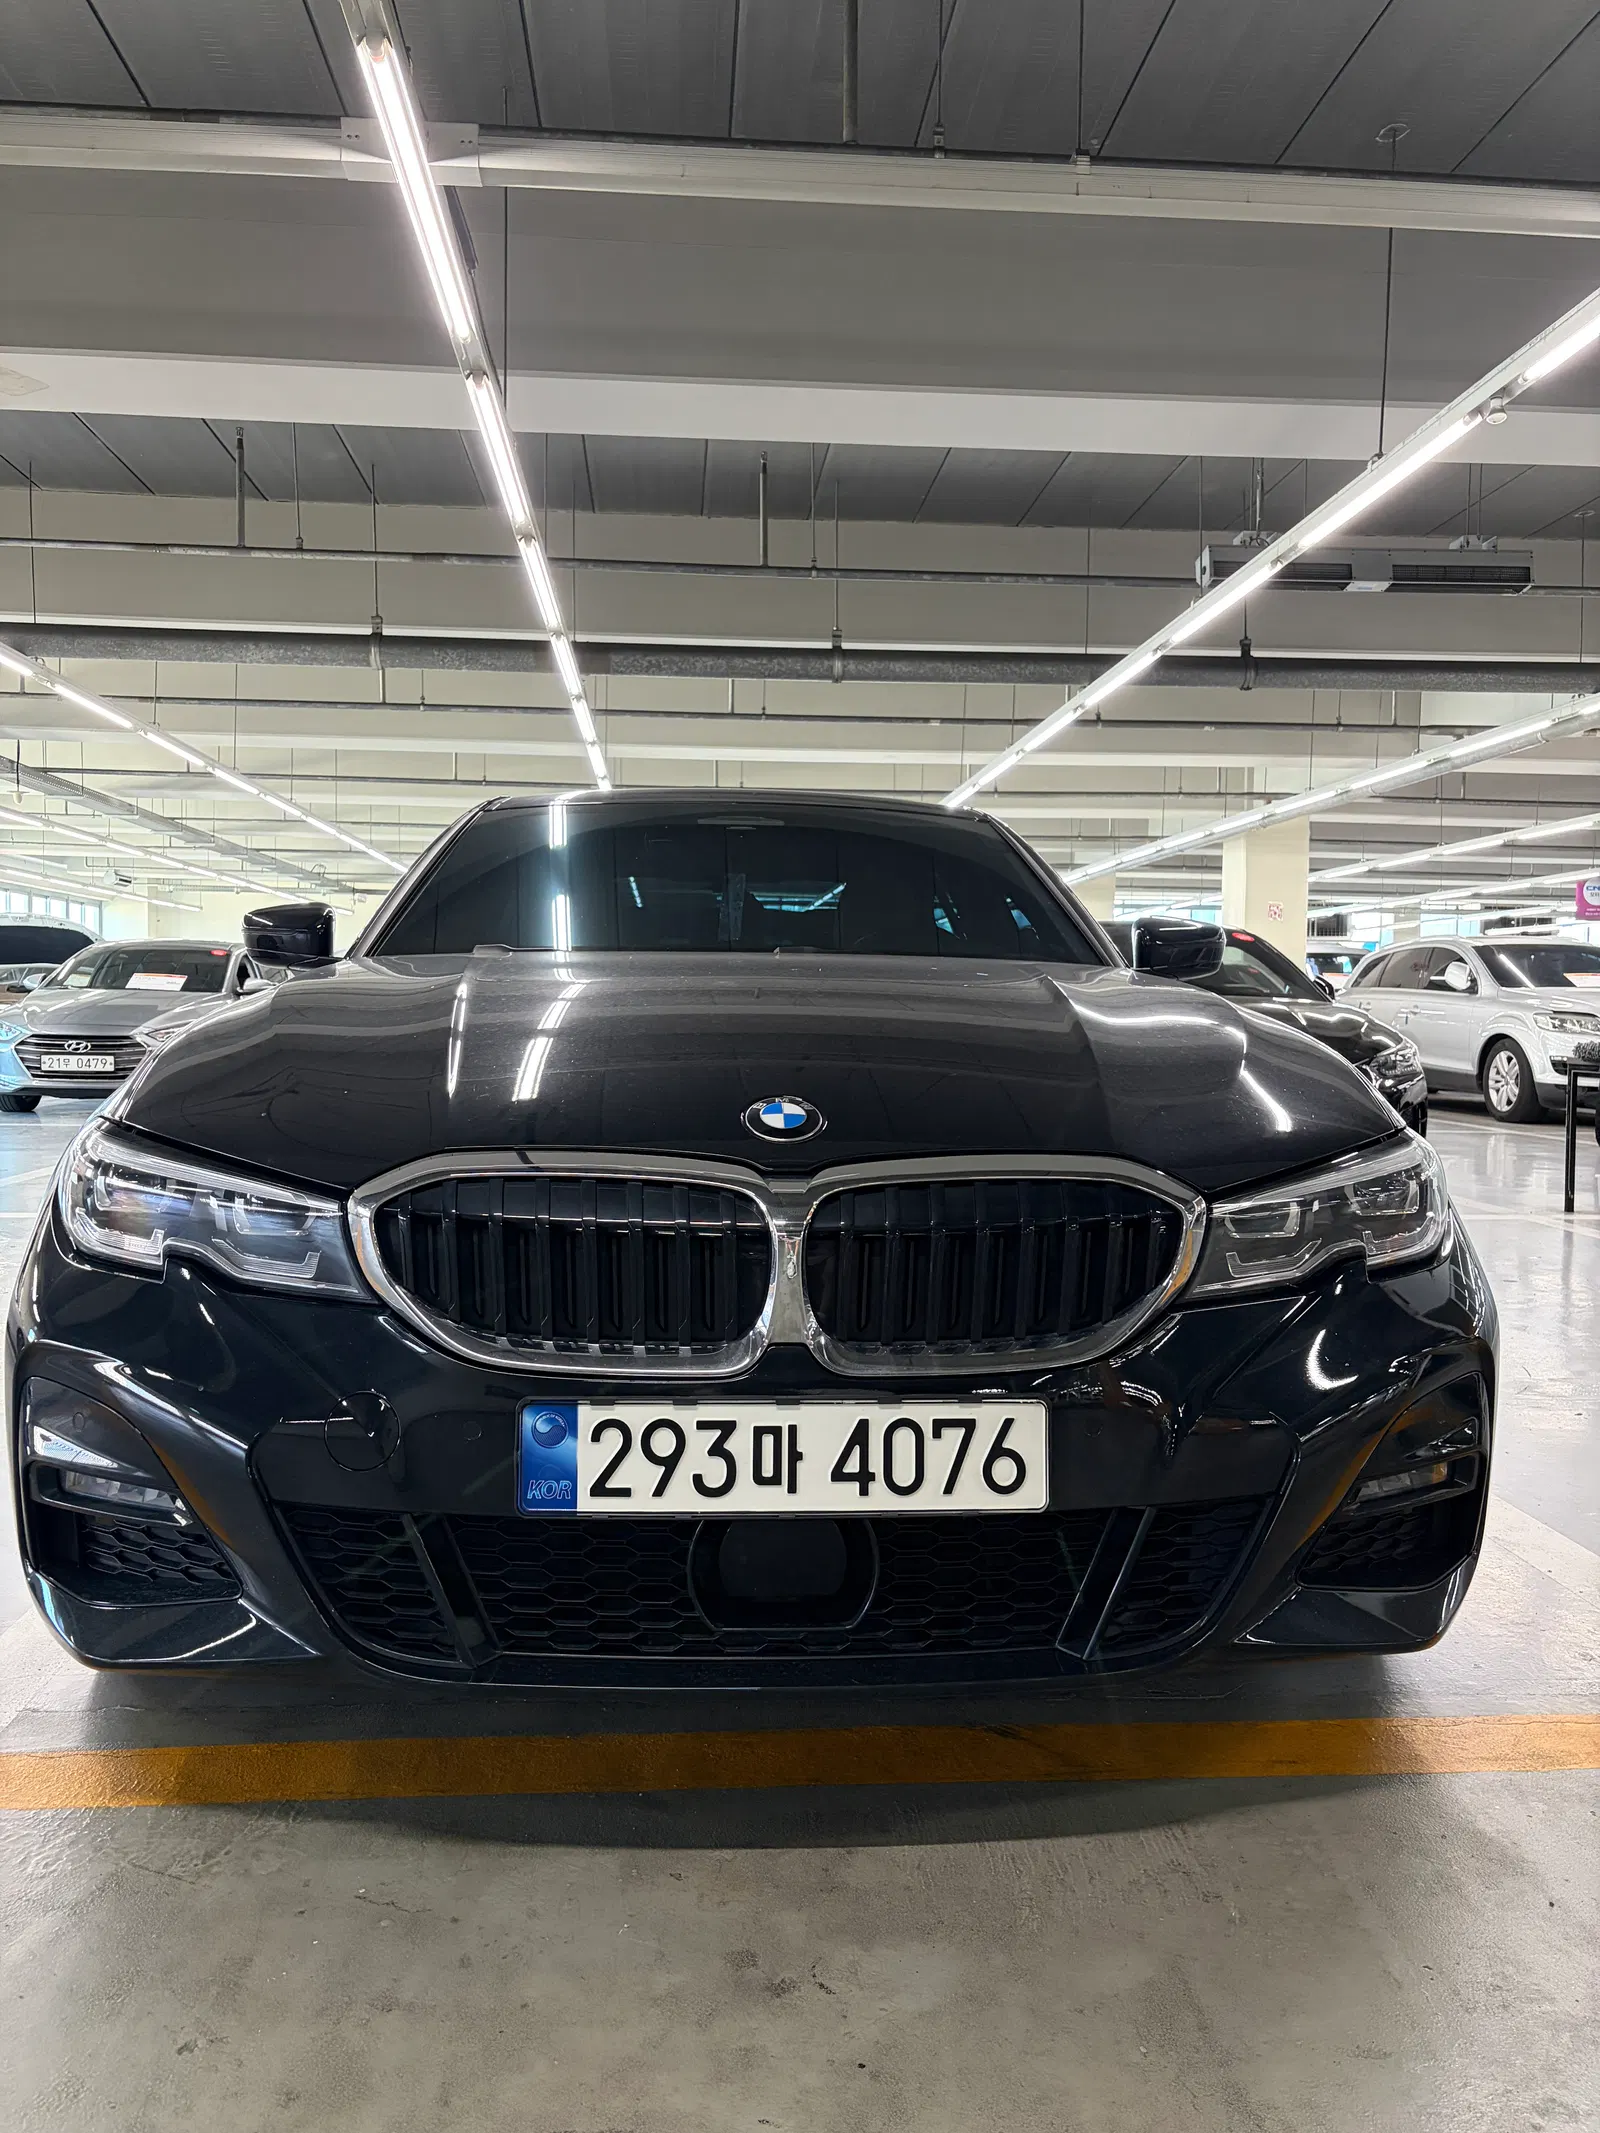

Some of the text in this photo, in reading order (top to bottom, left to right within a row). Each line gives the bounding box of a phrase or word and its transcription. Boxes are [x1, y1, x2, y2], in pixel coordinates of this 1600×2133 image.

[76, 1057, 108, 1069] 0479
[589, 1417, 1027, 1498] 293마 4076
[527, 1480, 572, 1499] KOR
